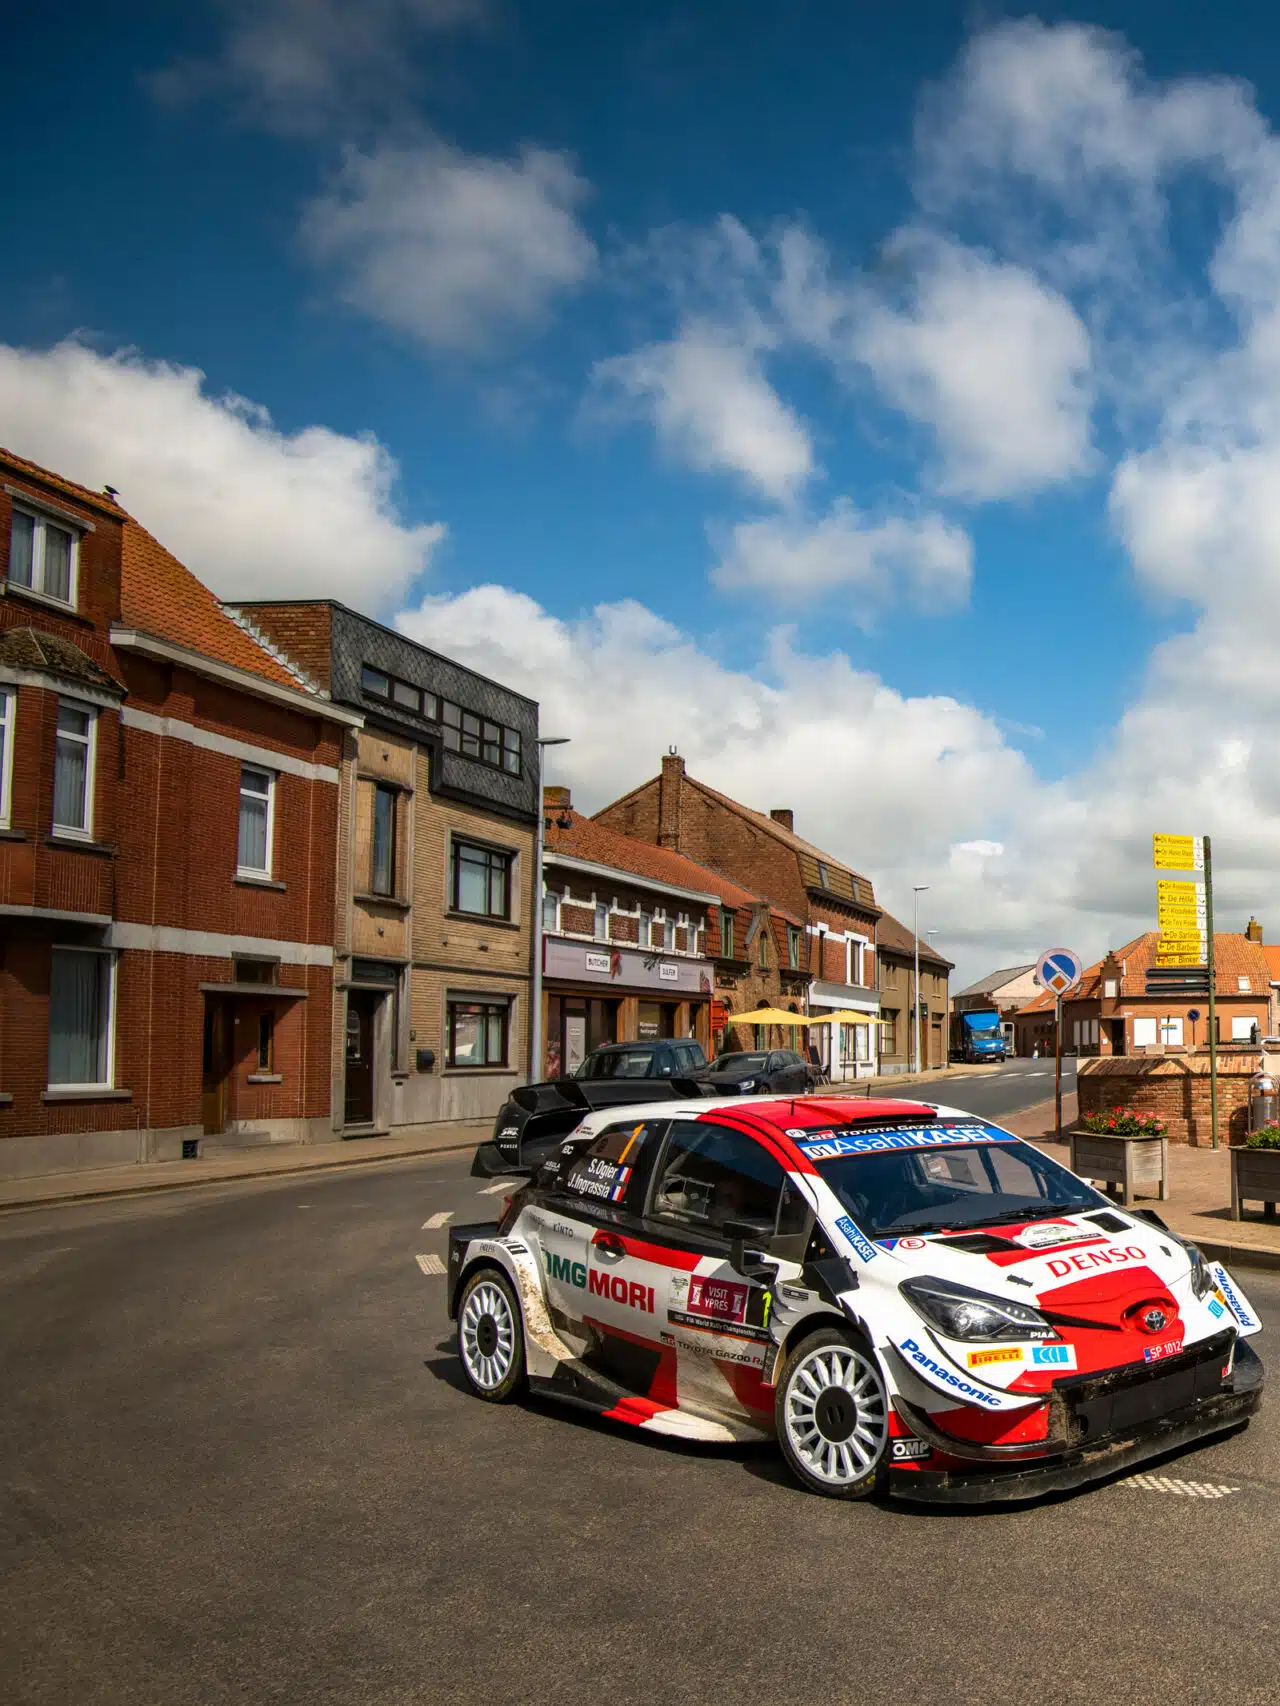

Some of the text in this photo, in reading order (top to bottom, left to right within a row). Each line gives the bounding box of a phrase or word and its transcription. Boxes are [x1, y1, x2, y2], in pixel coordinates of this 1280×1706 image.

[588, 957, 609, 968] BUTCHER
[838, 1127, 895, 1137] TOYOTA
[897, 1124, 943, 1132] GAZOO
[944, 1123, 985, 1131] Racing
[811, 1145, 829, 1157] 01
[588, 1158, 618, 1179] S.Ogier
[567, 1173, 611, 1198] J.Ingrassia
[1045, 1246, 1146, 1278] DENSO
[589, 1268, 655, 1313] MORI
[708, 1286, 728, 1299] VISIT
[1214, 1267, 1255, 1327] Panasonic
[704, 1296, 728, 1311] YPRES
[1030, 1331, 1056, 1339] PIAA
[676, 1340, 713, 1355] TOYOTA
[716, 1349, 751, 1363] GAZOO
[971, 1349, 1021, 1365] PIRELLI
[1150, 1341, 1182, 1359] SP 1012
[900, 1338, 1002, 1406] Panasonic
[892, 1441, 929, 1456] OMP
